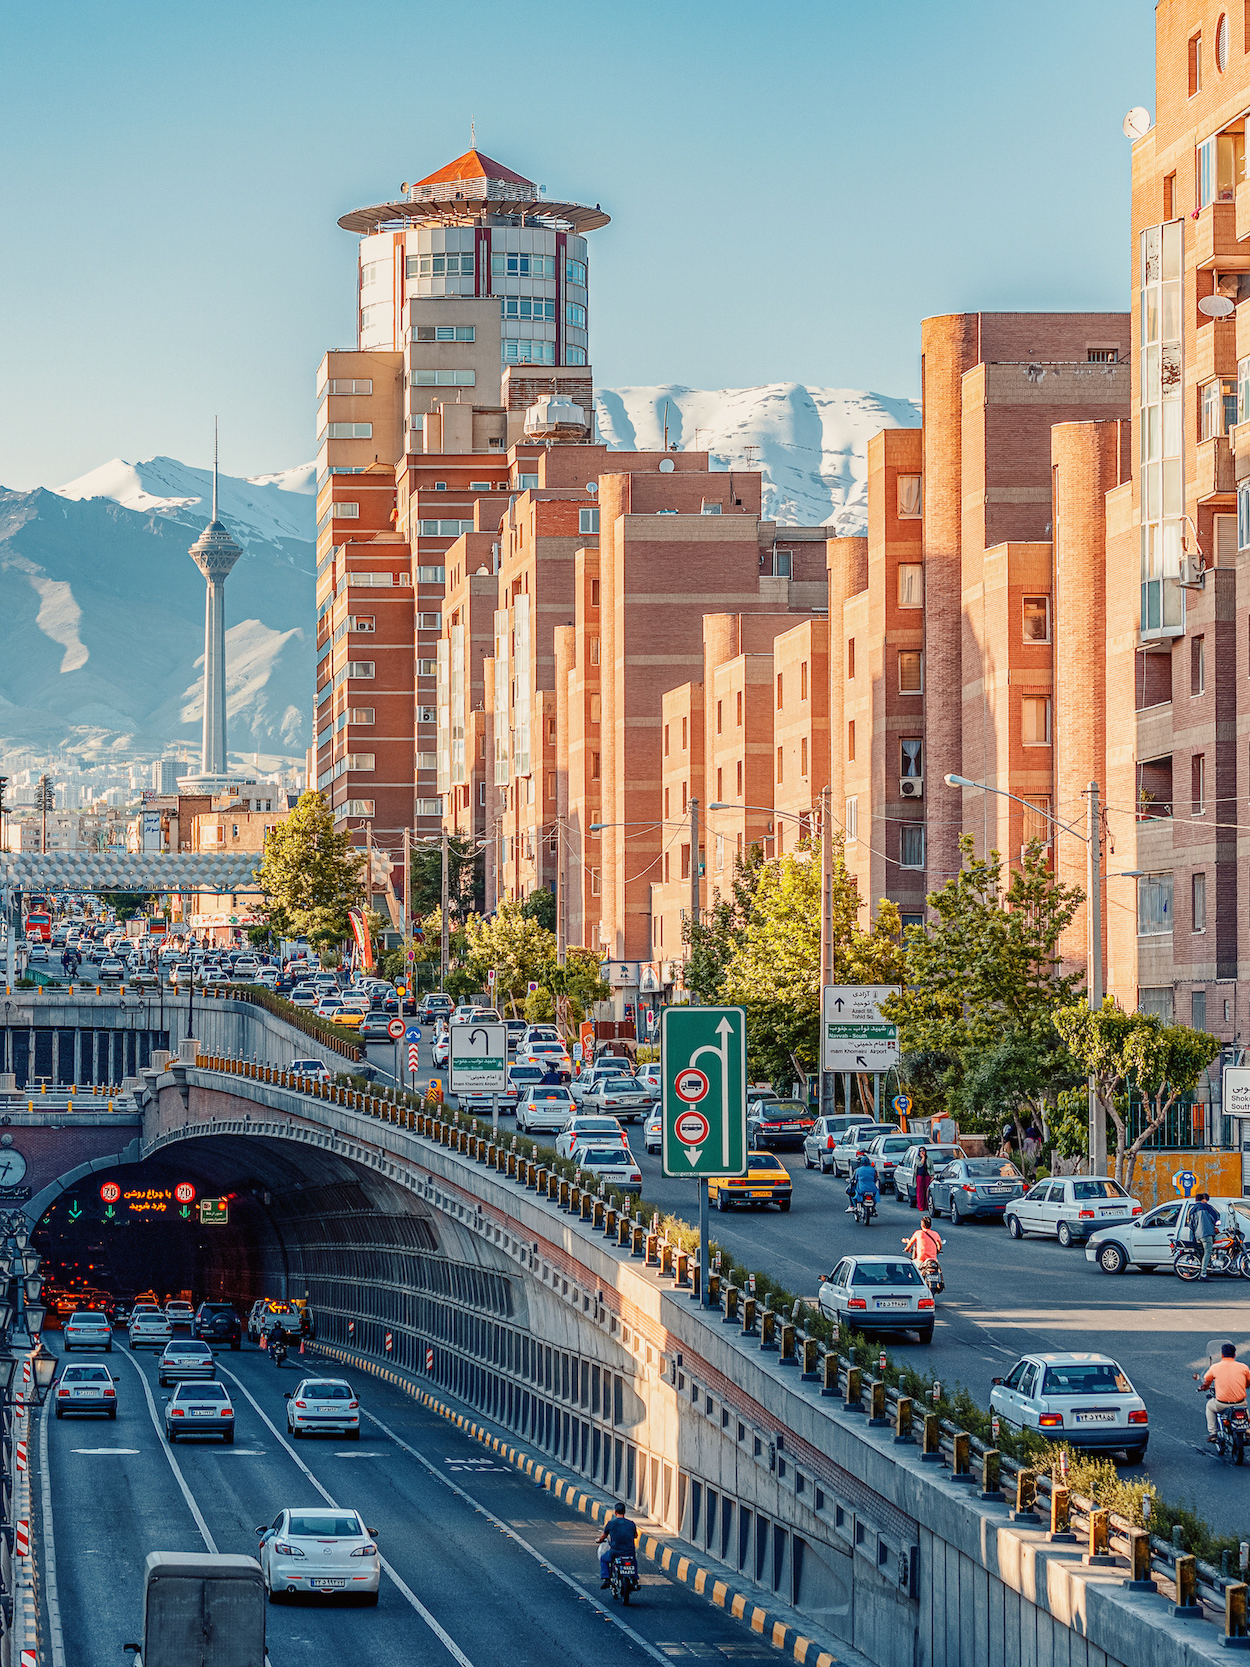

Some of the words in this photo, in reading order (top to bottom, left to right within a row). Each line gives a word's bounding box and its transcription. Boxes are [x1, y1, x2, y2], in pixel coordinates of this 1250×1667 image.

[853, 1000, 871, 1008] توحید
[829, 1025, 848, 1033] جنوب
[853, 1025, 870, 1033] نواب
[1231, 1094, 1250, 1102] Shok
[123, 1189, 146, 1199] روشن
[129, 1201, 150, 1212] شوید
